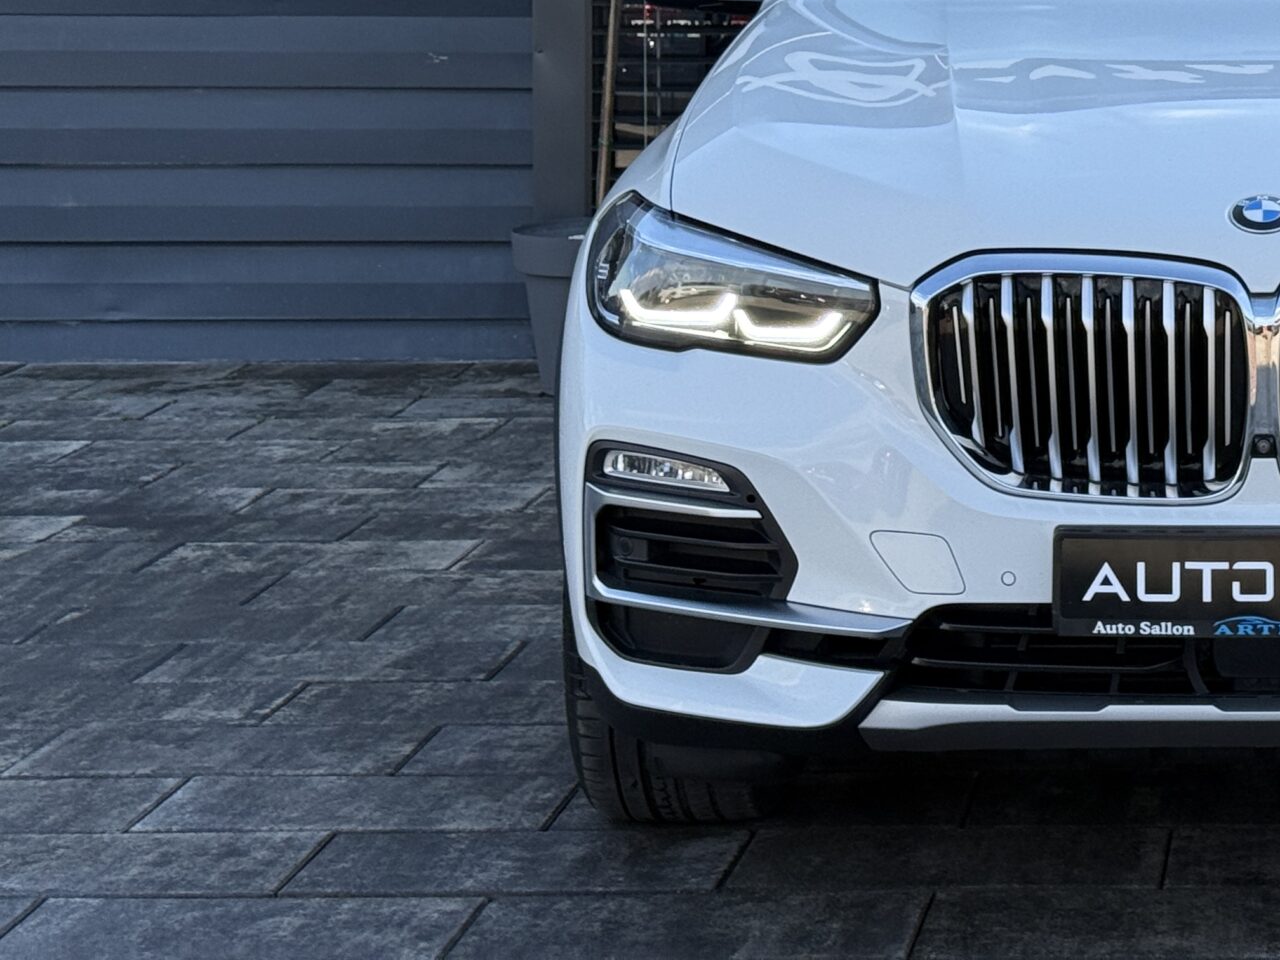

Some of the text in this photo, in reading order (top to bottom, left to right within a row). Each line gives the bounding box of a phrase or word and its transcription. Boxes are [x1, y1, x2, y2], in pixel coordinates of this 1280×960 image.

[1081, 561, 1274, 602] AUTO
[1092, 621, 1135, 635] Auto
[1139, 620, 1195, 636] Sallon
